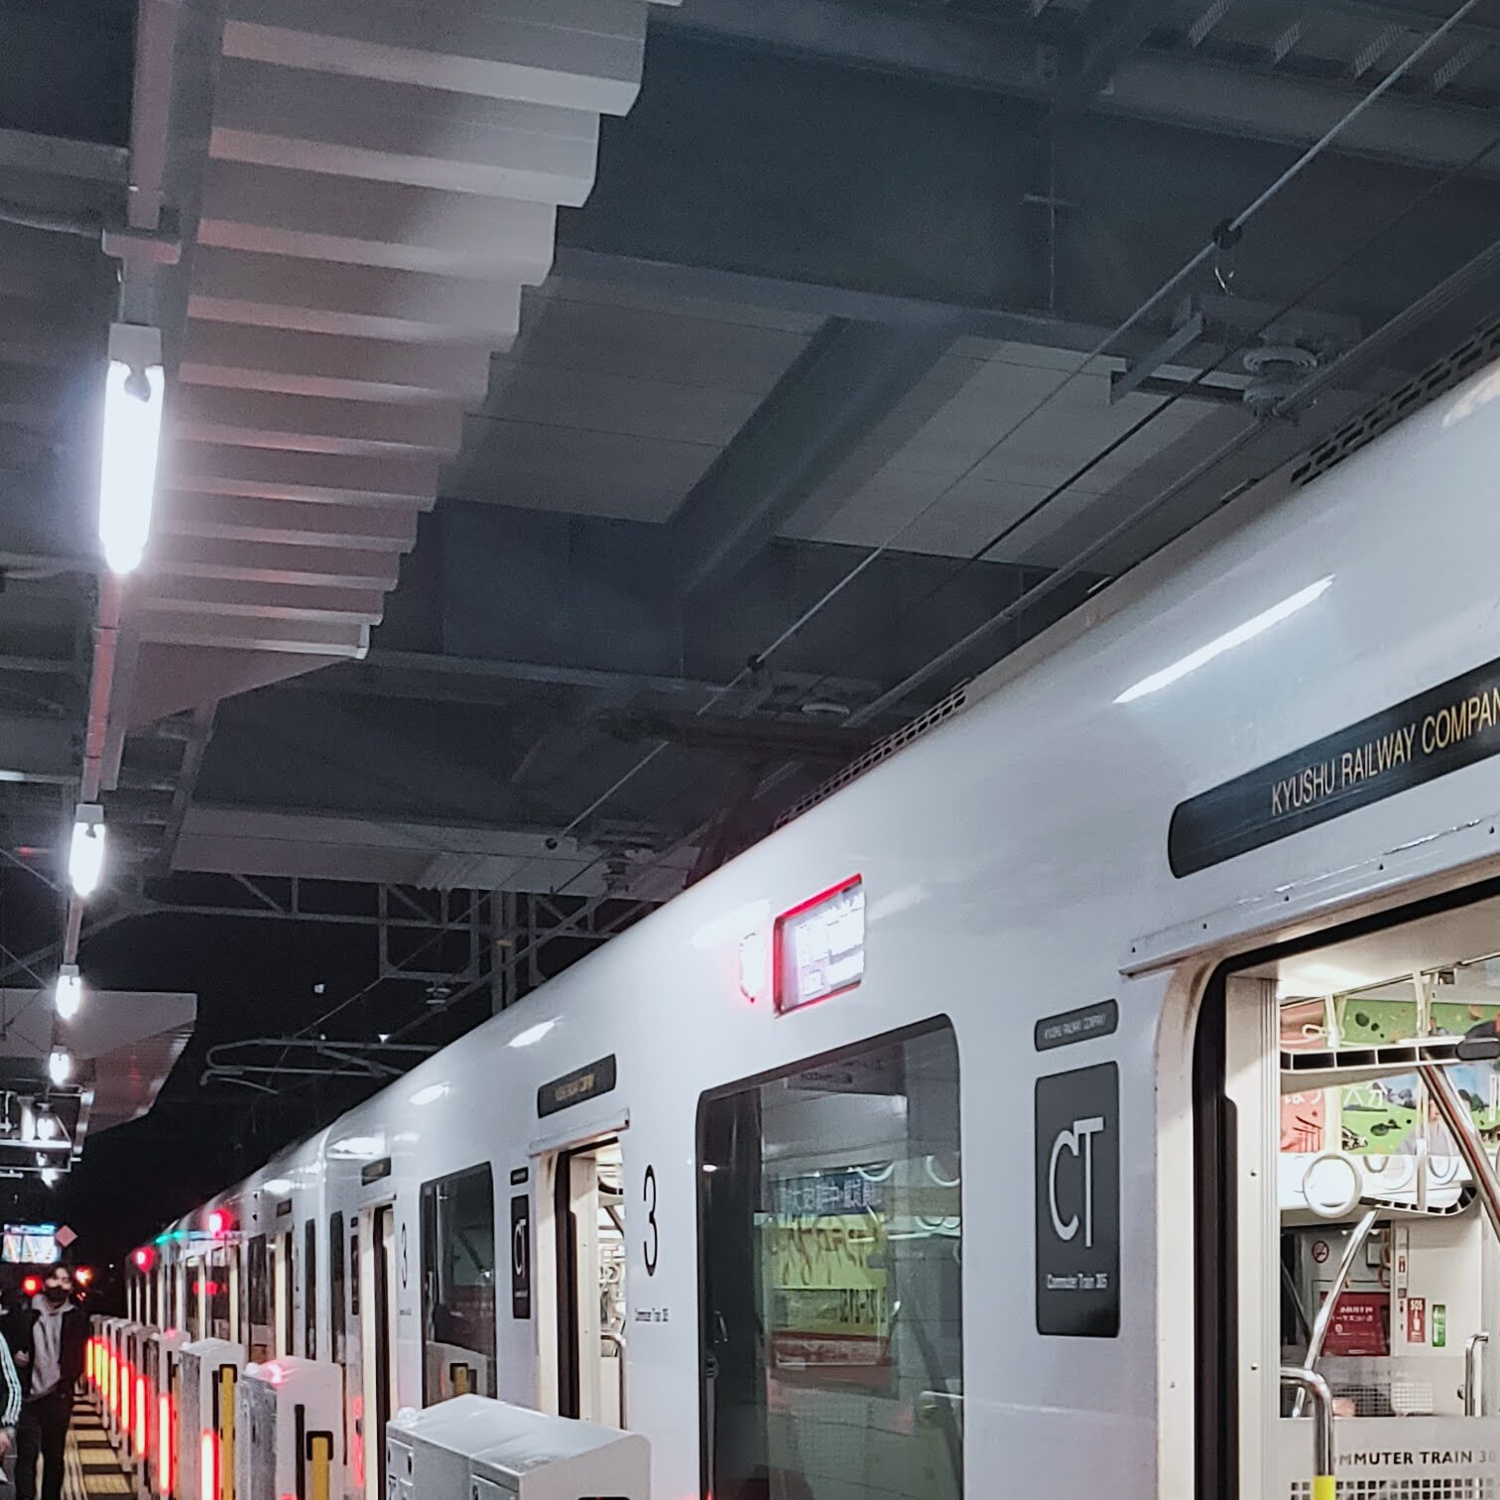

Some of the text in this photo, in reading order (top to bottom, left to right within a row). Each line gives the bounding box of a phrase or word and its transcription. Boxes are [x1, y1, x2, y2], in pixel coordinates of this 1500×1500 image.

[1271, 759, 1336, 816] KYUSHU
[1341, 723, 1416, 789] RAILWAY
[643, 1165, 659, 1277] 3
[1049, 1116, 1104, 1247] CT
[1334, 1451, 1414, 1466] MMUTER
[1418, 1450, 1472, 1465] TRAIN
